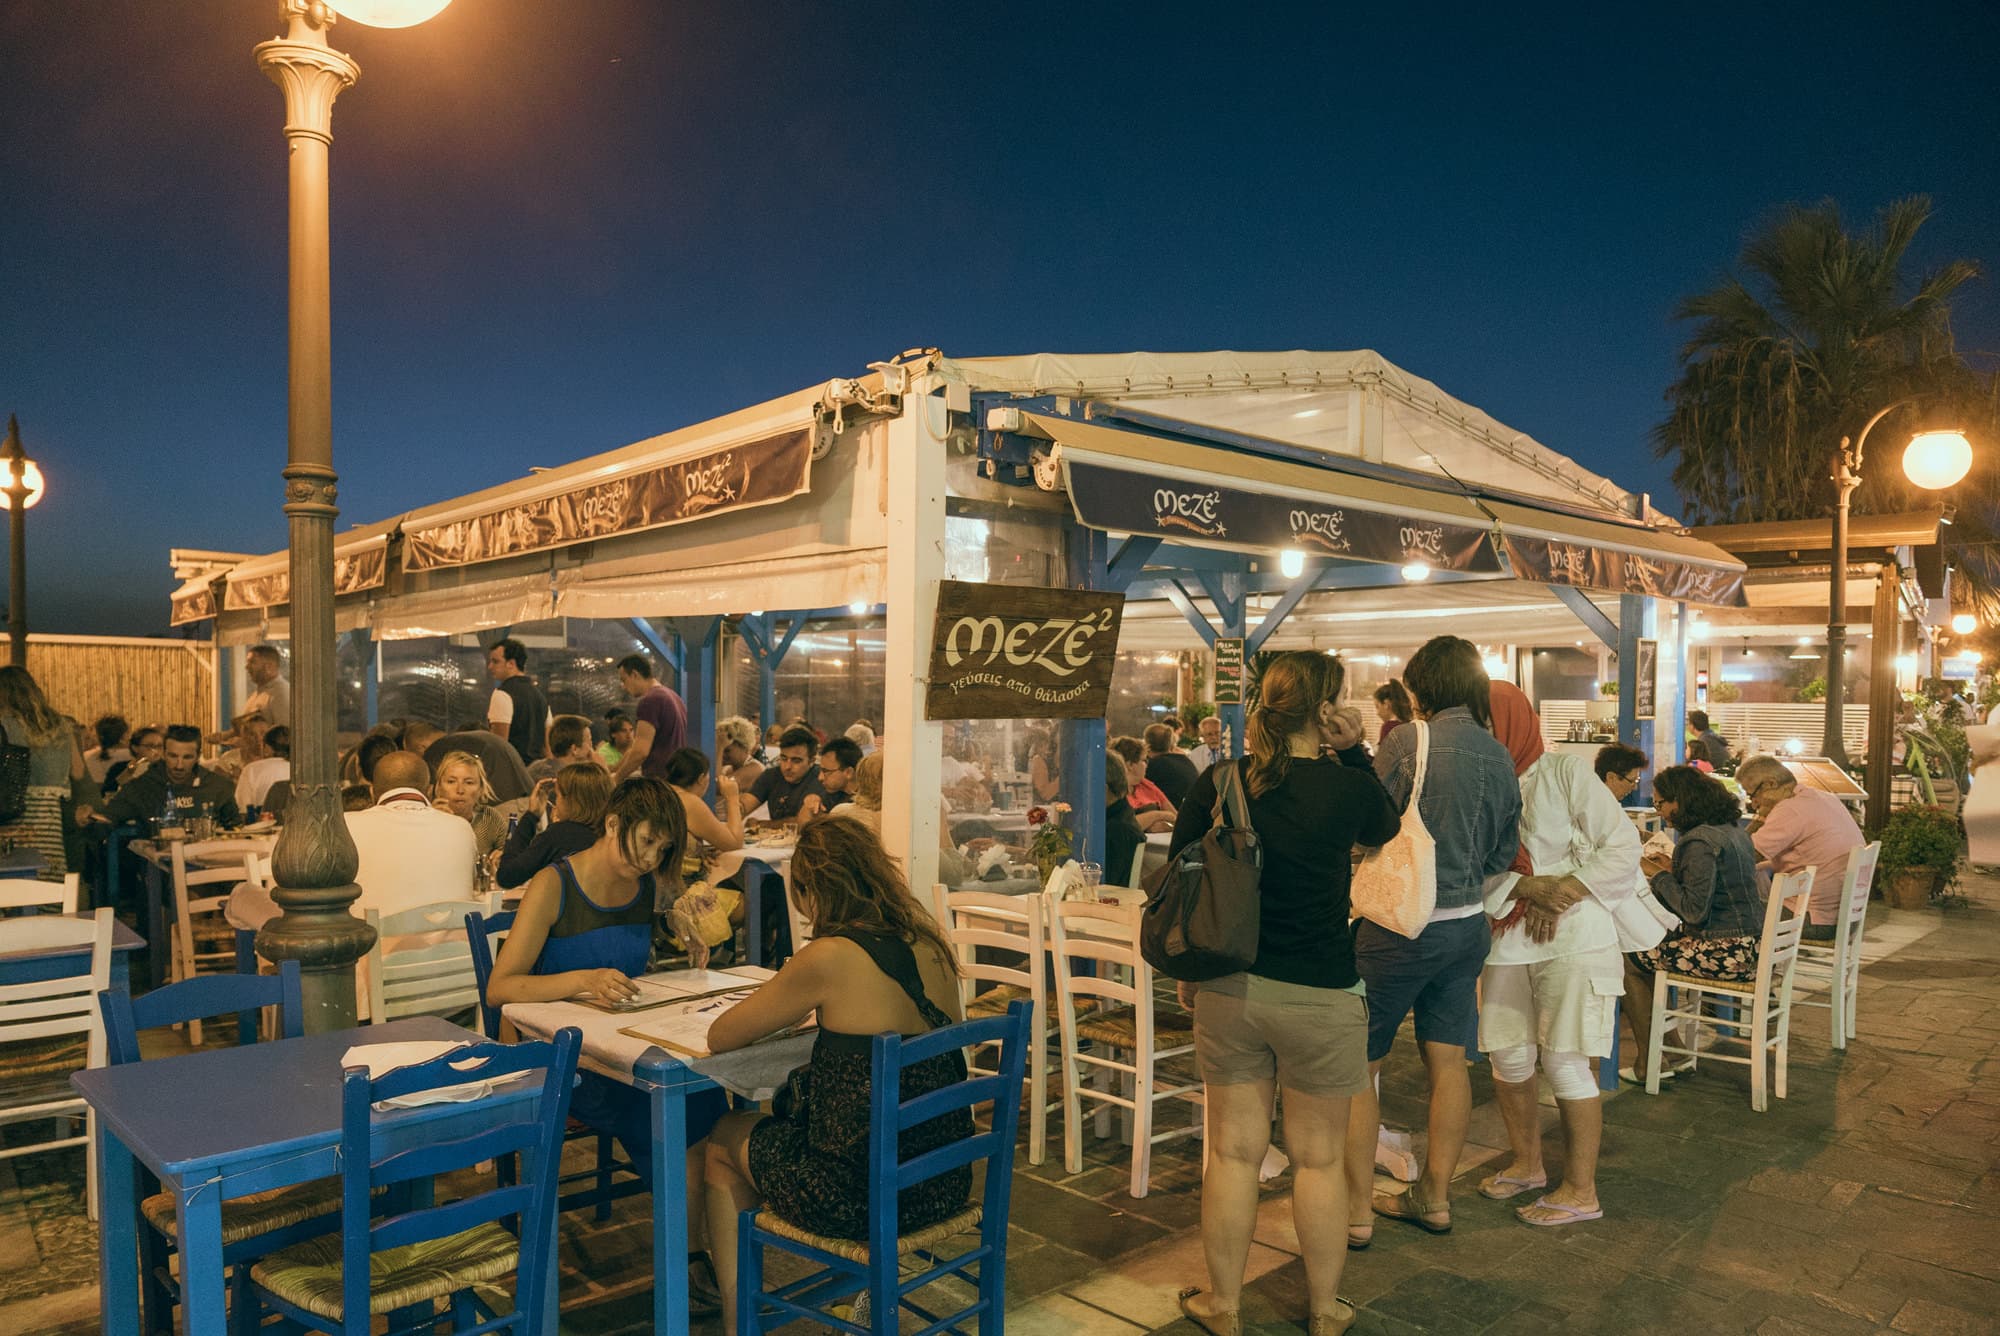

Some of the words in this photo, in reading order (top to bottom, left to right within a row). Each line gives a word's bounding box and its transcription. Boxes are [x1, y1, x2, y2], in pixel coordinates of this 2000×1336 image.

[950, 671, 1003, 695] γεύσεις
[1006, 678, 1031, 696] από
[1035, 679, 1091, 703] θάλασσα
